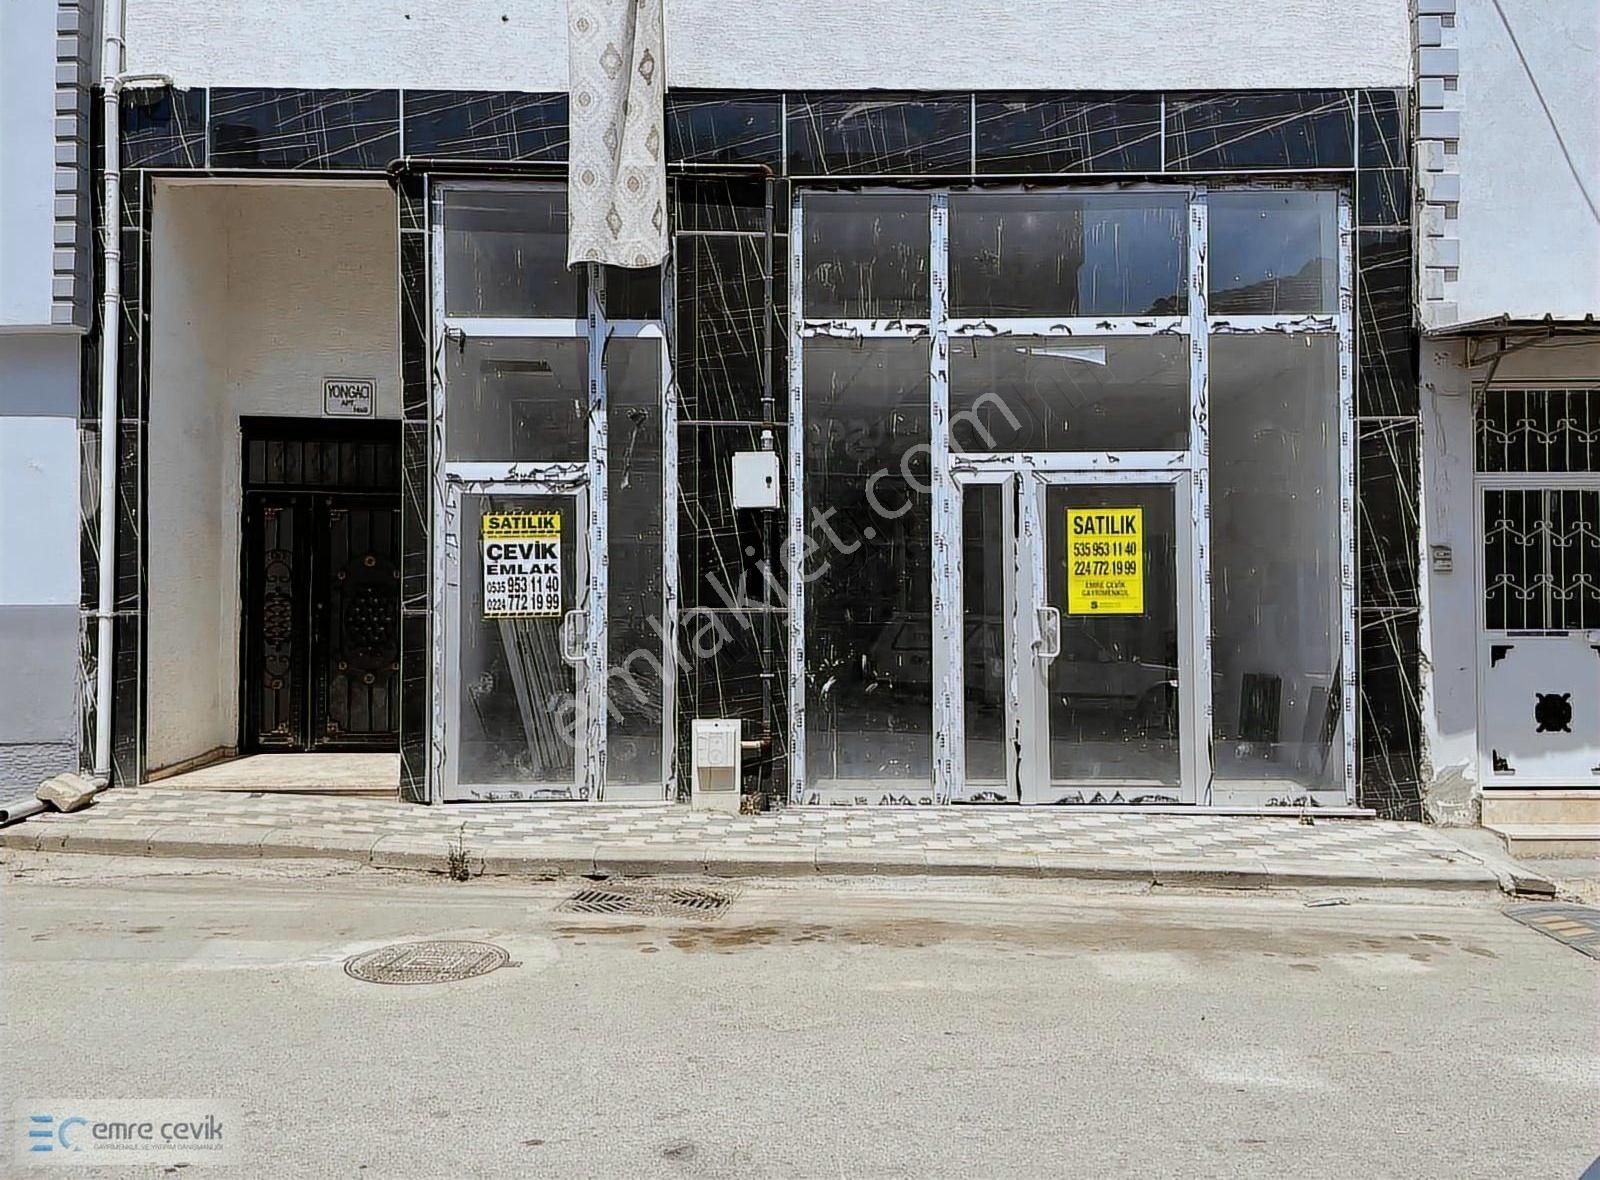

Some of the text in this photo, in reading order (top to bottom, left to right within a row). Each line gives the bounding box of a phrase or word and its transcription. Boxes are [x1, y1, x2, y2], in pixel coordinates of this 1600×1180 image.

[488, 517, 555, 529] SATILIK
[1073, 515, 1137, 535] SATILIK
[486, 541, 558, 563] ÇEVİK
[1074, 542, 1091, 557] 535
[1092, 542, 1110, 557] 953
[1124, 542, 1137, 556] 40
[486, 564, 558, 576] EMLAK
[1074, 560, 1137, 576] 224 772 19 99
[507, 576, 528, 593] 953
[531, 576, 542, 593] 11
[545, 576, 559, 593] 40
[508, 594, 528, 611] 772
[531, 594, 543, 610] 19
[546, 593, 559, 610] 99
